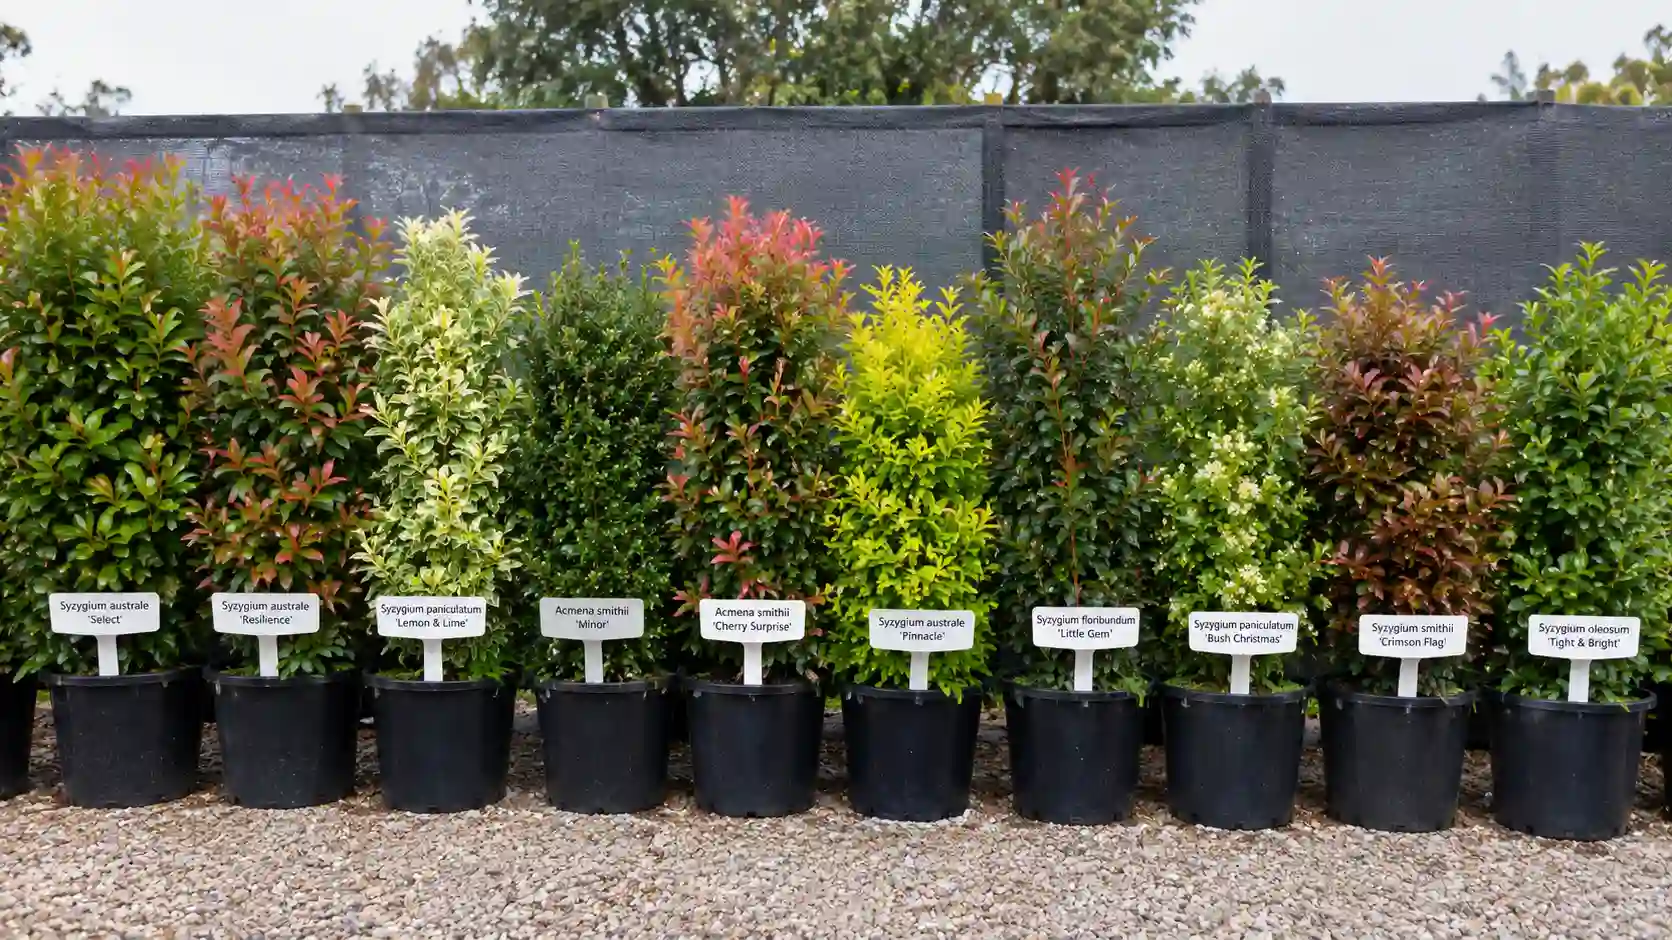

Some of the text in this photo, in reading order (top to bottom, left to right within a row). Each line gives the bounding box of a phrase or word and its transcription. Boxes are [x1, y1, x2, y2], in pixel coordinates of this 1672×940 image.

[59, 600, 150, 613] Syzygium australe
[221, 600, 310, 613] Syzygium australe
[380, 603, 482, 616] Syzygium paniculatum
[555, 605, 629, 616] Acmena smithii
[714, 607, 790, 618] Acmena smithii
[87, 615, 123, 625] 'Select'
[239, 614, 293, 625] 'Resilience'
[395, 618, 469, 628] 'Lemon & Lime'
[575, 619, 610, 630] 'Minor'
[878, 616, 966, 629] Syzygium australe
[1036, 614, 1136, 627] Syzygium floribundum
[1194, 619, 1294, 632] Syzygium paniculatum
[712, 621, 792, 634] 'Cherry Surprise'
[1057, 628, 1113, 639] 'Little Gem'
[1371, 622, 1454, 635] Syzygium smithii
[1538, 622, 1630, 636] Syzygium oleosum
[899, 631, 946, 641] 'Pinnacle'
[1205, 633, 1283, 644] 'Bush Christmas'
[1379, 636, 1447, 650] 'Crimson Flag'
[1547, 637, 1621, 651] 'Tight & Bright'
